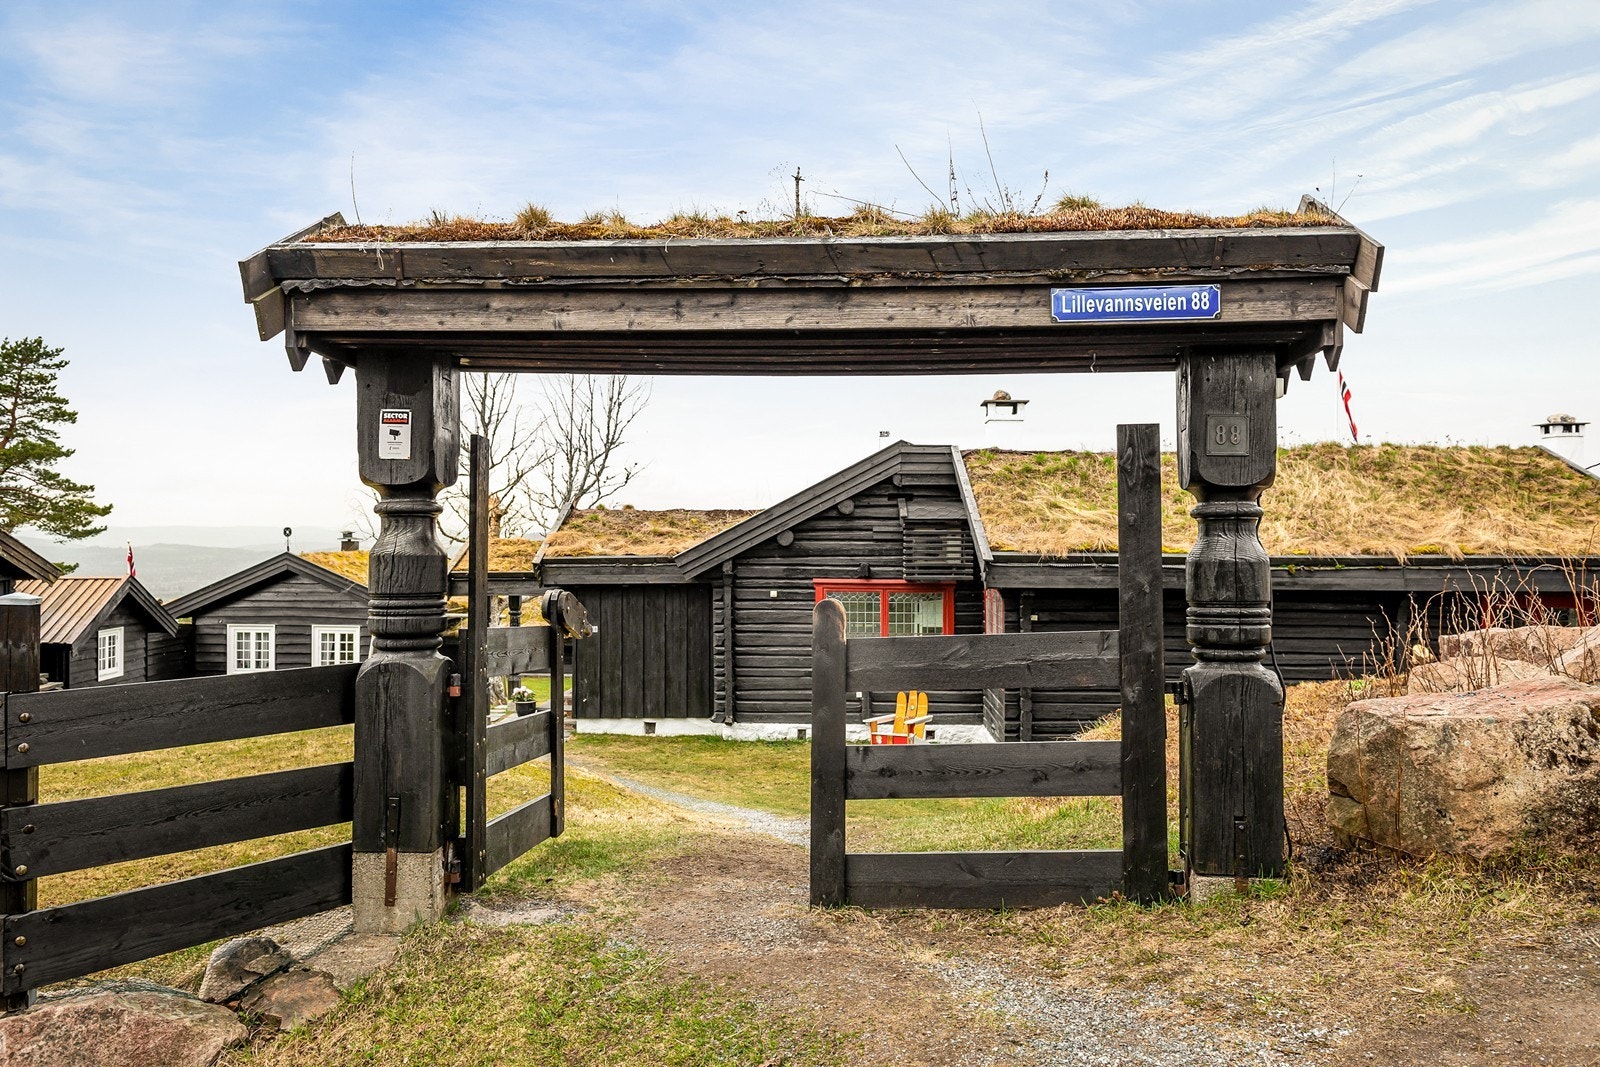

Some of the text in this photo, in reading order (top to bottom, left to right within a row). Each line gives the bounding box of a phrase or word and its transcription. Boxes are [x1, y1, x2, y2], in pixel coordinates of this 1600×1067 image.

[1061, 291, 1210, 314] Lillevannsveien 88
[1215, 424, 1241, 445] 88
